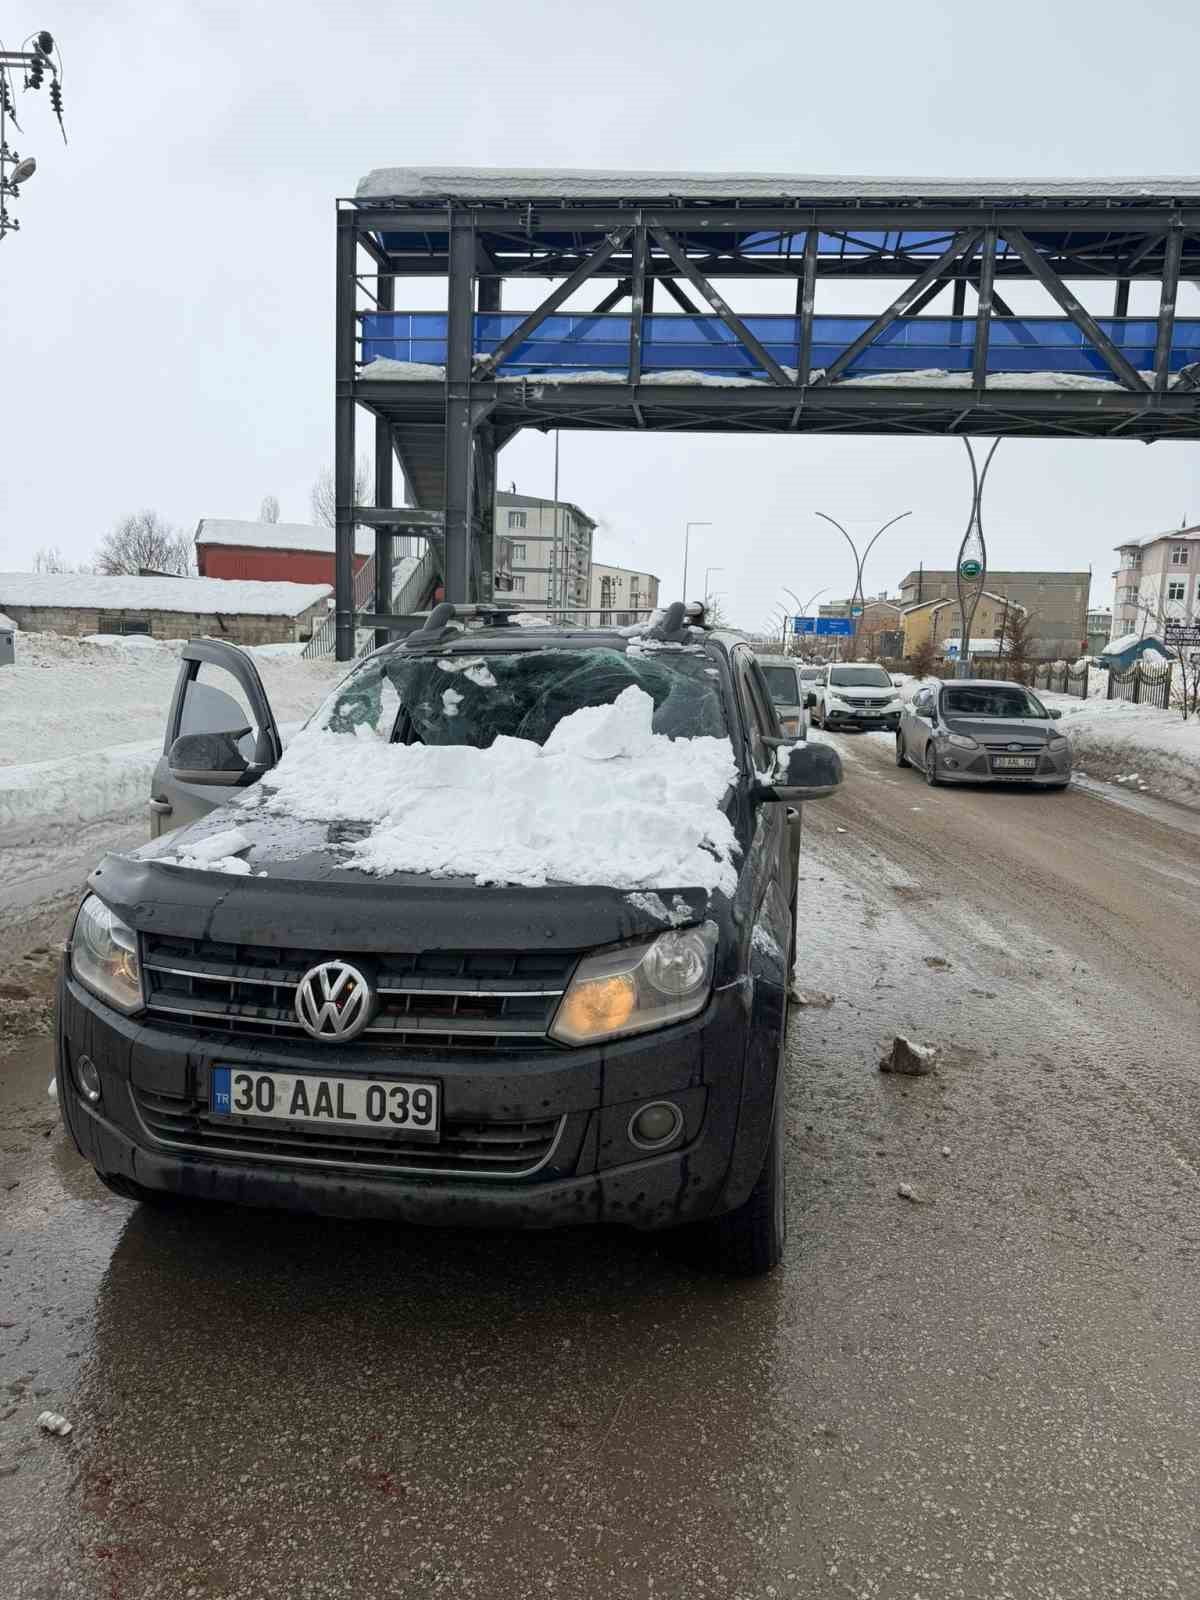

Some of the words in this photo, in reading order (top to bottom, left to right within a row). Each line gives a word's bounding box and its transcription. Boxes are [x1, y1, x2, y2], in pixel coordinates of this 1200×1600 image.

[216, 1092, 229, 1105] TR
[234, 1074, 275, 1112] 30
[289, 1079, 357, 1120] AAL
[366, 1084, 433, 1126] 039
